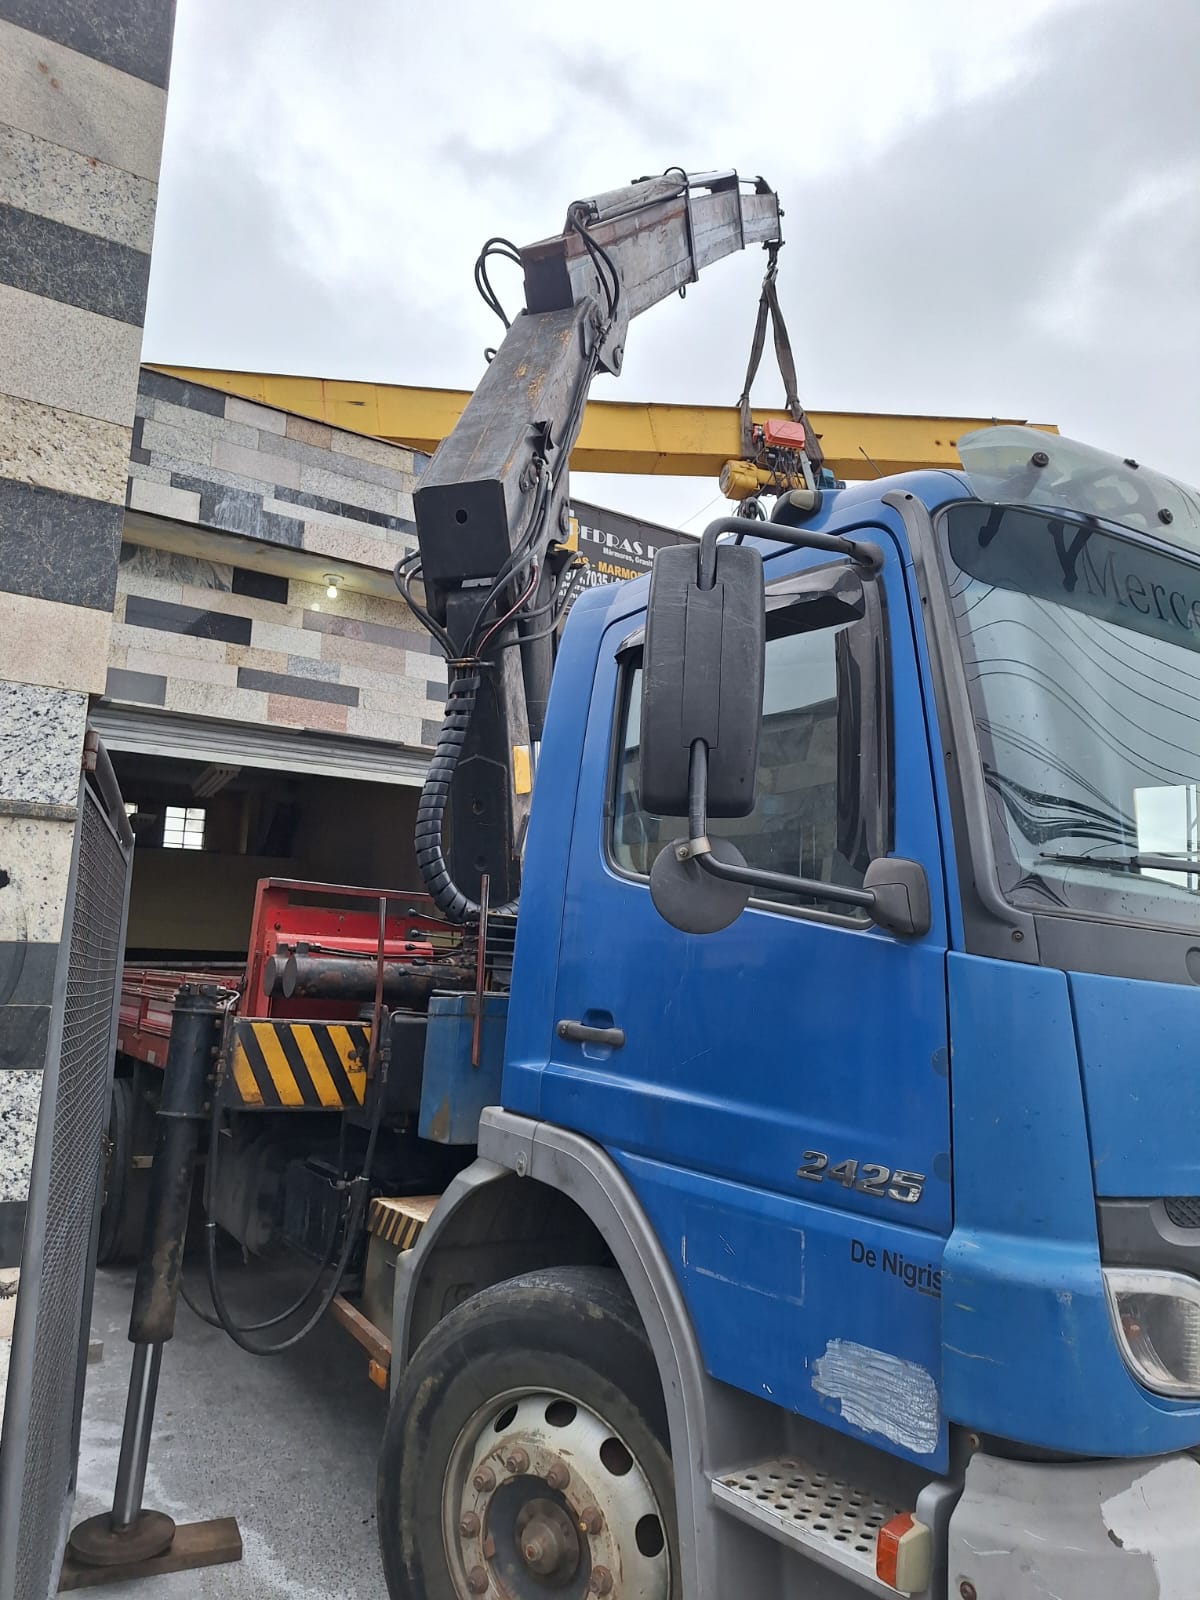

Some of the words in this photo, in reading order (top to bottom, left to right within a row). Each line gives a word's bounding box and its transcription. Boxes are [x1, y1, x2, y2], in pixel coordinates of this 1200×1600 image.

[797, 1150, 926, 1203] 2425
[851, 1239, 877, 1268] De
[883, 1249, 941, 1290] Nigris
